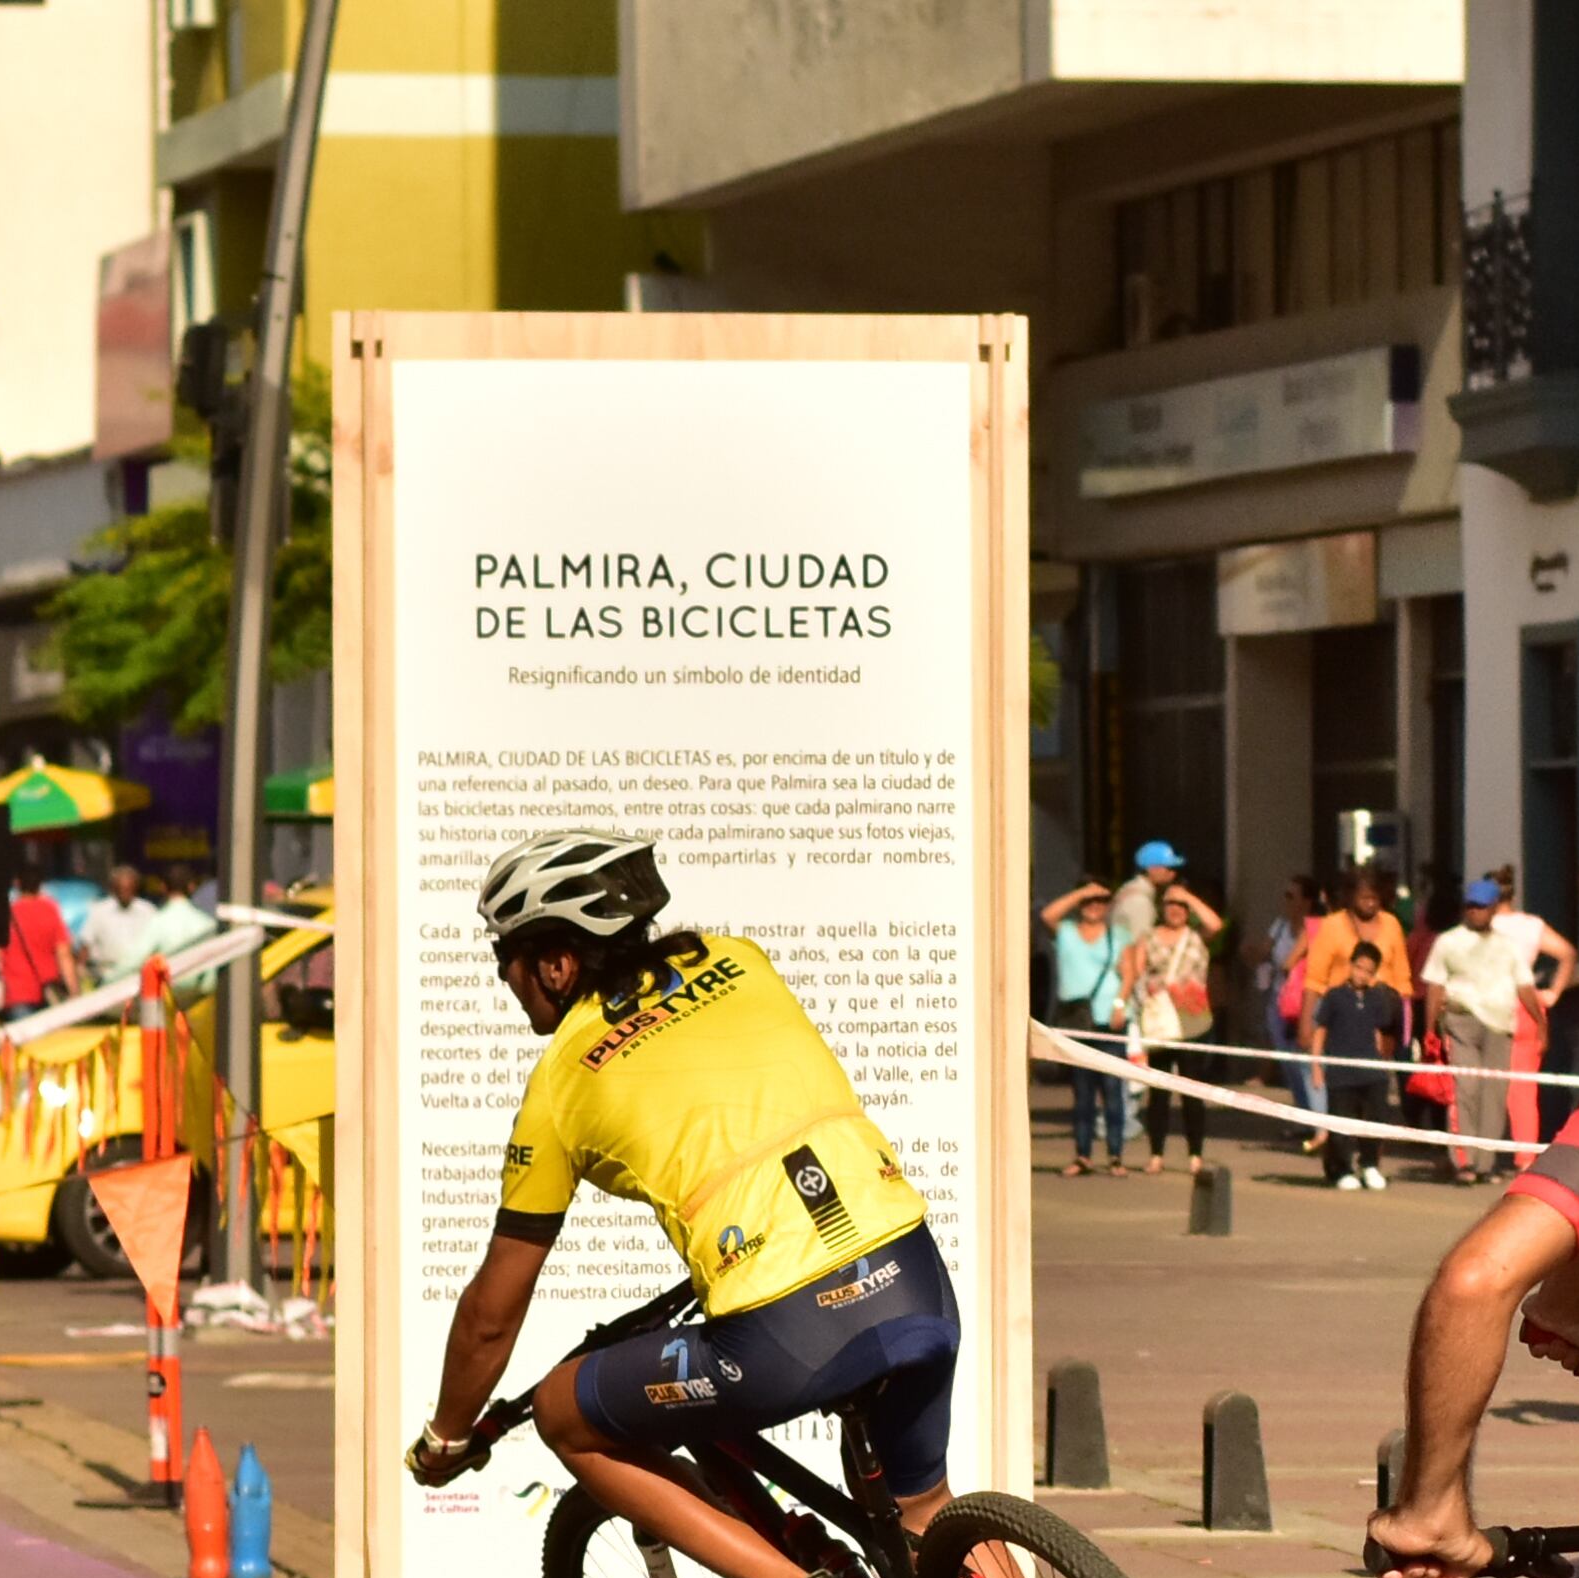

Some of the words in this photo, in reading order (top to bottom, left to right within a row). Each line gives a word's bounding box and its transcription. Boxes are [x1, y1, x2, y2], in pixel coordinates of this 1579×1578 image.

[475, 553, 688, 597] PALMIRA,
[705, 552, 889, 590] CIUDAD
[476, 606, 526, 638] DE
[545, 605, 624, 639] LAS
[642, 605, 892, 639] BICICLETAS
[508, 664, 638, 689] Resignificando
[645, 670, 666, 684] un
[673, 665, 744, 685] símbolo
[749, 665, 771, 685] de
[777, 664, 861, 685] identidad
[418, 751, 493, 768] PALMIRA,
[498, 750, 561, 768] CIUDAD
[566, 750, 585, 767] DE
[592, 750, 620, 767] LAS
[625, 749, 711, 768] BICICLETAS
[716, 754, 737, 769] es,
[742, 753, 768, 770] por
[773, 749, 827, 766] encima
[832, 749, 852, 766] de
[856, 753, 875, 766] un
[923, 753, 933, 770] y
[937, 749, 956, 766] de
[418, 779, 447, 793] una
[452, 775, 528, 793] referencia
[533, 775, 547, 792] al
[552, 775, 612, 796] pasado,
[618, 779, 638, 793] un
[643, 774, 693, 792] deseo.
[699, 774, 732, 791] Para
[737, 778, 766, 795] que
[771, 773, 827, 791] Palmira
[832, 778, 858, 792] sea
[863, 774, 876, 791] la
[881, 773, 932, 791] ciudad
[937, 773, 956, 791] de
[418, 800, 439, 817] las
[444, 800, 515, 817] bicicletas
[520, 801, 618, 818] necesitamos,
[624, 802, 663, 816] entre
[668, 801, 706, 816] otras
[762, 802, 790, 819] que
[795, 798, 830, 816] cada
[835, 798, 912, 819] palmirano
[917, 801, 956, 815] narre
[418, 828, 436, 842] su
[440, 825, 497, 842] historia
[501, 828, 528, 842] con
[668, 824, 703, 840] cada
[708, 822, 785, 843] palmirano
[789, 826, 834, 843] saque
[838, 826, 862, 839] sus
[867, 822, 904, 840] fotos
[909, 823, 955, 844] viejas,
[419, 850, 491, 867] amarillas
[678, 848, 776, 868] compartirlas
[787, 852, 797, 869] y
[807, 848, 872, 865] recordar
[883, 848, 955, 866] nombres,
[419, 923, 461, 940] Cada
[742, 923, 805, 938] mostrar
[816, 921, 877, 941] aquella
[889, 920, 956, 938] bicicleta
[788, 946, 829, 964] años,
[838, 949, 864, 962] esa
[872, 949, 899, 962] con
[907, 945, 920, 962] la
[929, 949, 957, 966] que
[420, 972, 480, 991] empezó
[486, 976, 495, 988] a
[824, 973, 851, 987] con
[856, 969, 869, 987] la
[875, 973, 904, 990] que
[948, 974, 957, 987] a
[421, 999, 480, 1015] mercar,
[493, 995, 508, 1012] la
[828, 997, 838, 1014] y
[848, 997, 878, 1014] que
[890, 993, 904, 1010] el
[916, 993, 957, 1010] nieto
[620, 983, 738, 1059] ANTIPINCHAZOS
[838, 1021, 919, 1039] compartan
[924, 1021, 957, 1034] esos
[421, 1046, 482, 1061] recortes
[489, 1044, 508, 1061] de
[856, 1042, 869, 1058] la
[877, 1042, 927, 1058] noticia
[935, 1042, 957, 1058] del
[421, 1070, 466, 1088] padre
[471, 1072, 481, 1085] o
[487, 1069, 511, 1086] del
[854, 1066, 867, 1082] al
[873, 1066, 913, 1084] Valle,
[920, 1069, 939, 1082] en
[945, 1066, 957, 1082] la
[421, 1093, 470, 1109] Vuelta
[473, 1096, 482, 1109] a
[911, 1136, 930, 1153] de
[938, 1137, 958, 1153] los
[940, 1161, 958, 1176] de
[422, 1188, 497, 1206] Industrias
[422, 1215, 489, 1232] graneros
[422, 1238, 478, 1254] retratar
[587, 1236, 606, 1252] de
[613, 1235, 649, 1254] vida,
[422, 1263, 467, 1277] crecer
[577, 1260, 672, 1277] necesitamos
[422, 1284, 441, 1301] de
[550, 1286, 607, 1300] nuestra
